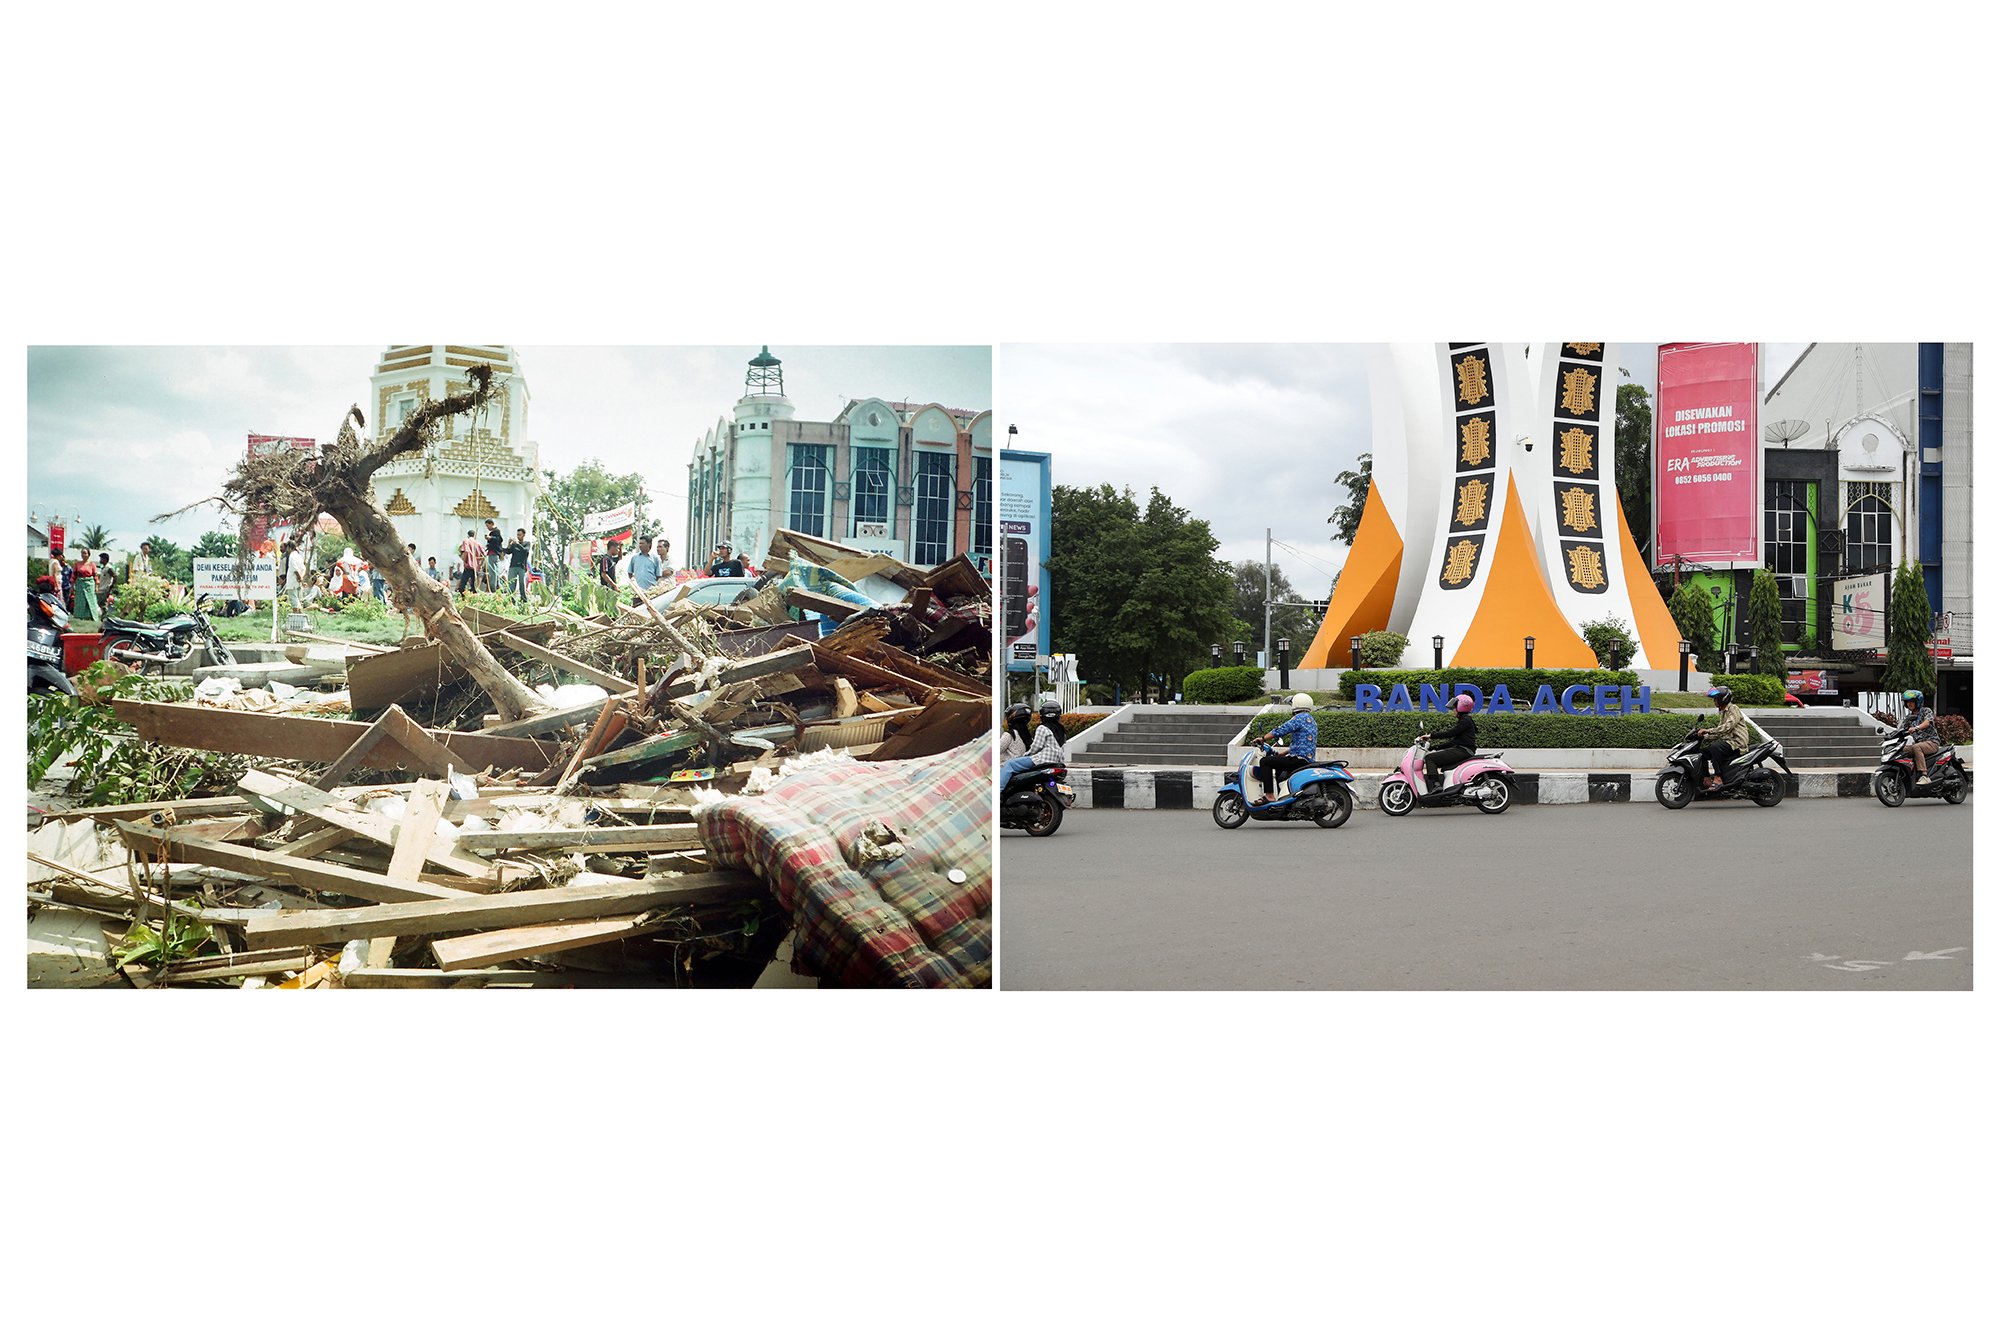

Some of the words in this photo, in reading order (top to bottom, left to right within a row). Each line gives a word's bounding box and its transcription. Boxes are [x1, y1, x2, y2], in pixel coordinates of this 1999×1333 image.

[1675, 405, 1733, 422] DISEWAKAN
[1665, 423, 1696, 438] LOKASI
[1697, 420, 1745, 434] PROMOSI
[1667, 457, 1690, 472] ERA
[1712, 472, 1732, 482] 0400
[196, 563, 211, 571] DEMI
[256, 563, 273, 571] ANDA
[1051, 655, 1070, 683] Bank
[1355, 683, 1516, 715] BANDA
[1531, 684, 1650, 717] ACEH
